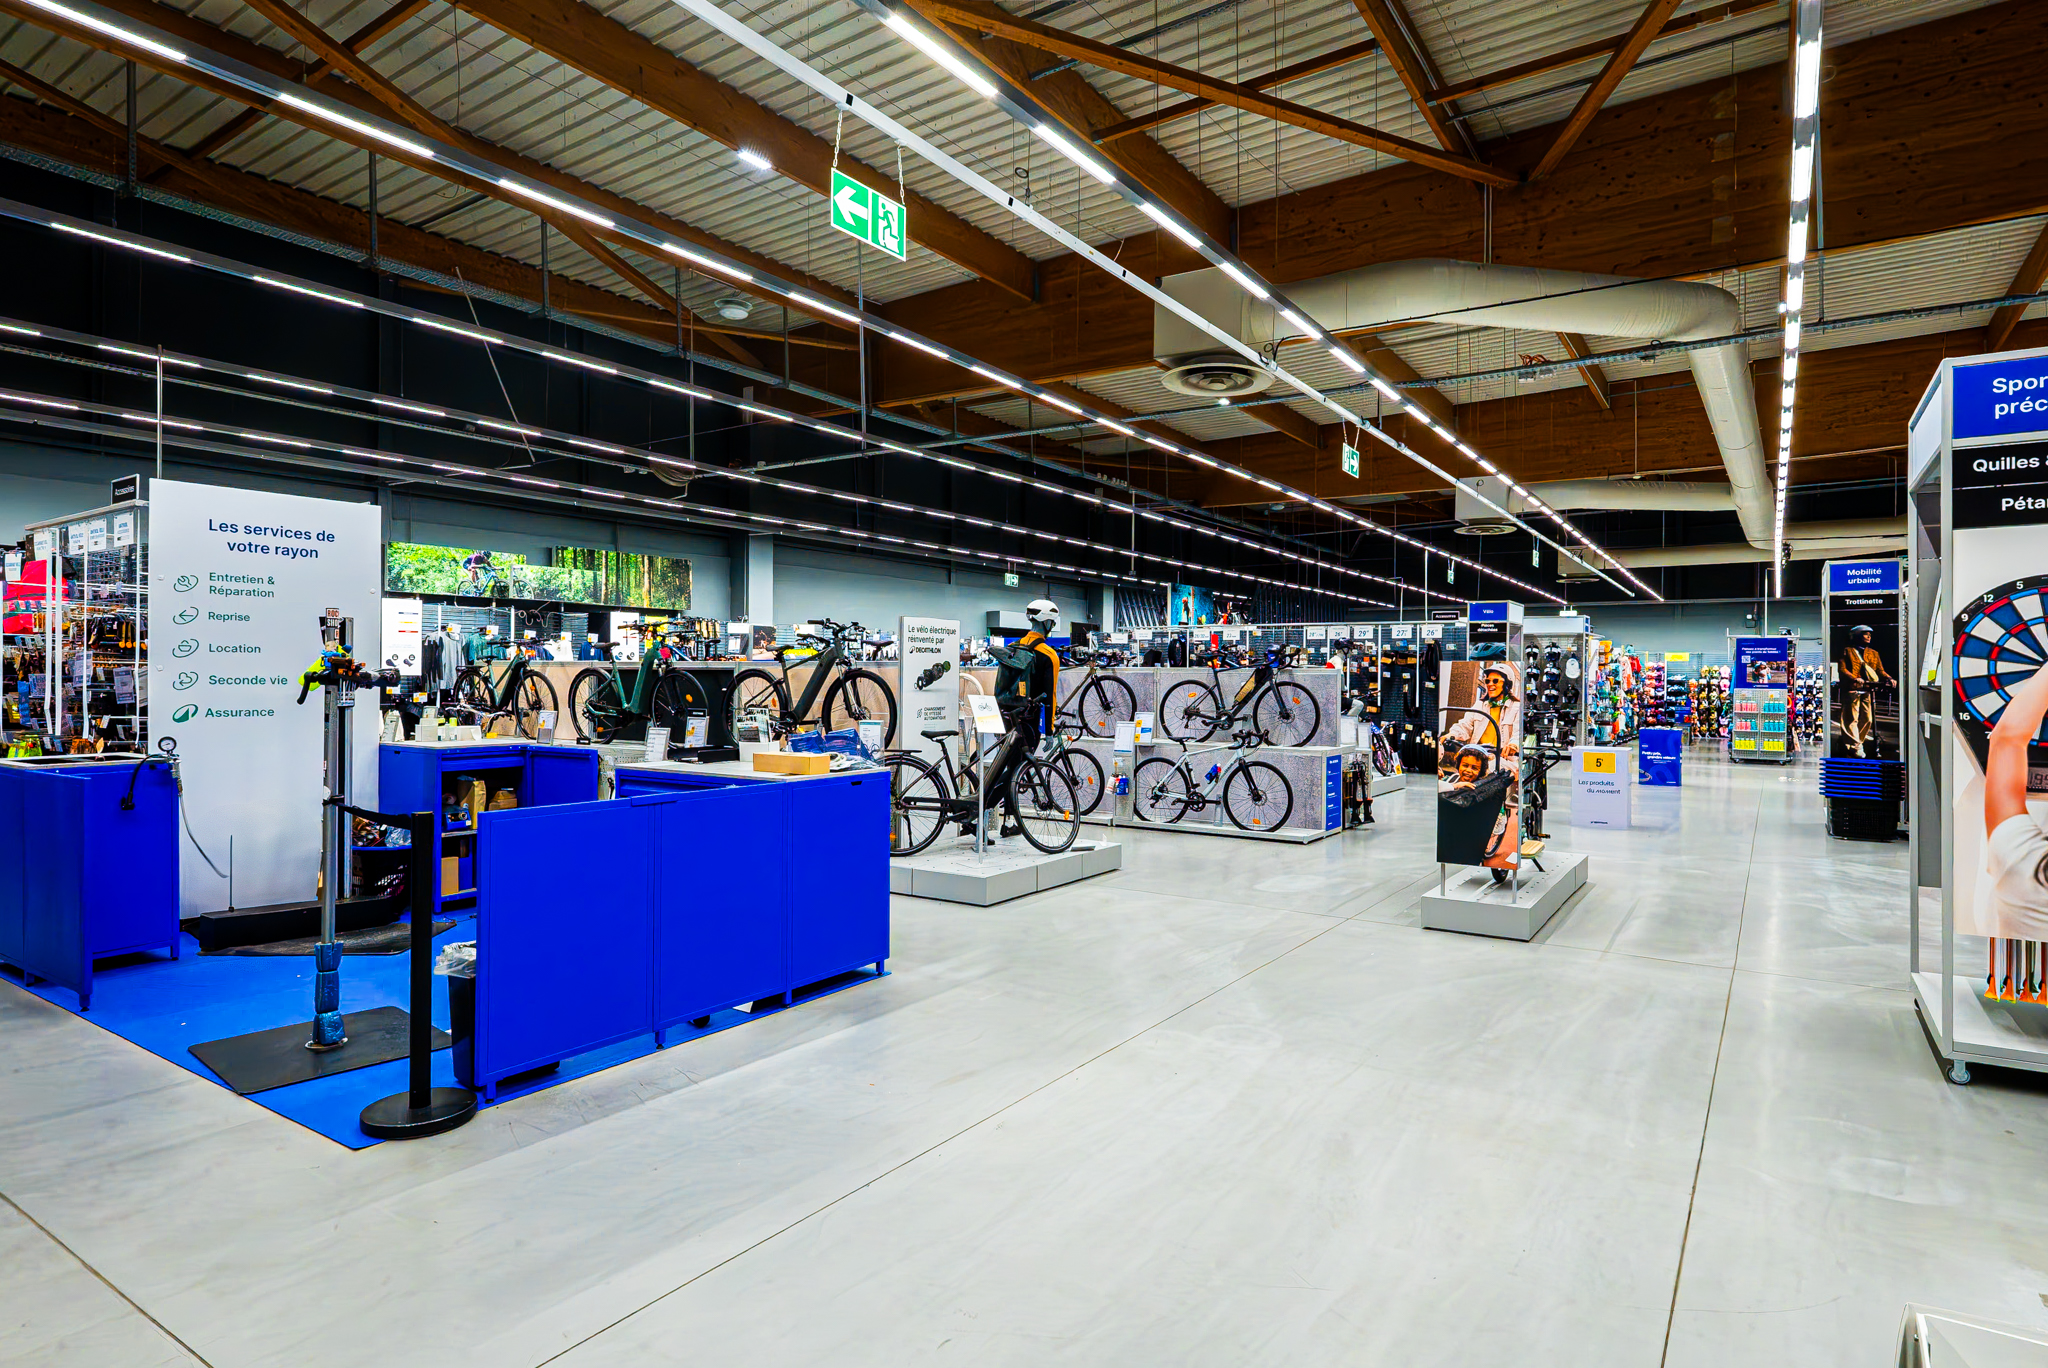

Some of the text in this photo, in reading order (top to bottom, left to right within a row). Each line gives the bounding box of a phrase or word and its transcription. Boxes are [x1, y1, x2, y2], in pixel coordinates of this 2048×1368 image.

[1994, 396, 2048, 419] préc
[1973, 456, 2040, 473] Quilles
[2001, 496, 2048, 512] Péta
[208, 518, 335, 543] Les services de
[227, 541, 319, 560] votre rayon
[1847, 568, 1882, 576] Mobilité
[209, 572, 275, 585] Entretien &
[2016, 581, 2024, 590] 5
[209, 585, 275, 598] Réparation
[1983, 594, 1994, 603] 12
[208, 612, 251, 623] Reprise
[1961, 613, 1969, 622] 9
[908, 625, 957, 636] Le vélo électrique
[908, 635, 945, 645] réinventé par
[208, 643, 261, 654] Location
[208, 675, 288, 686] Seconde vie
[205, 707, 275, 718] Assurance
[1959, 712, 1970, 721] 16
